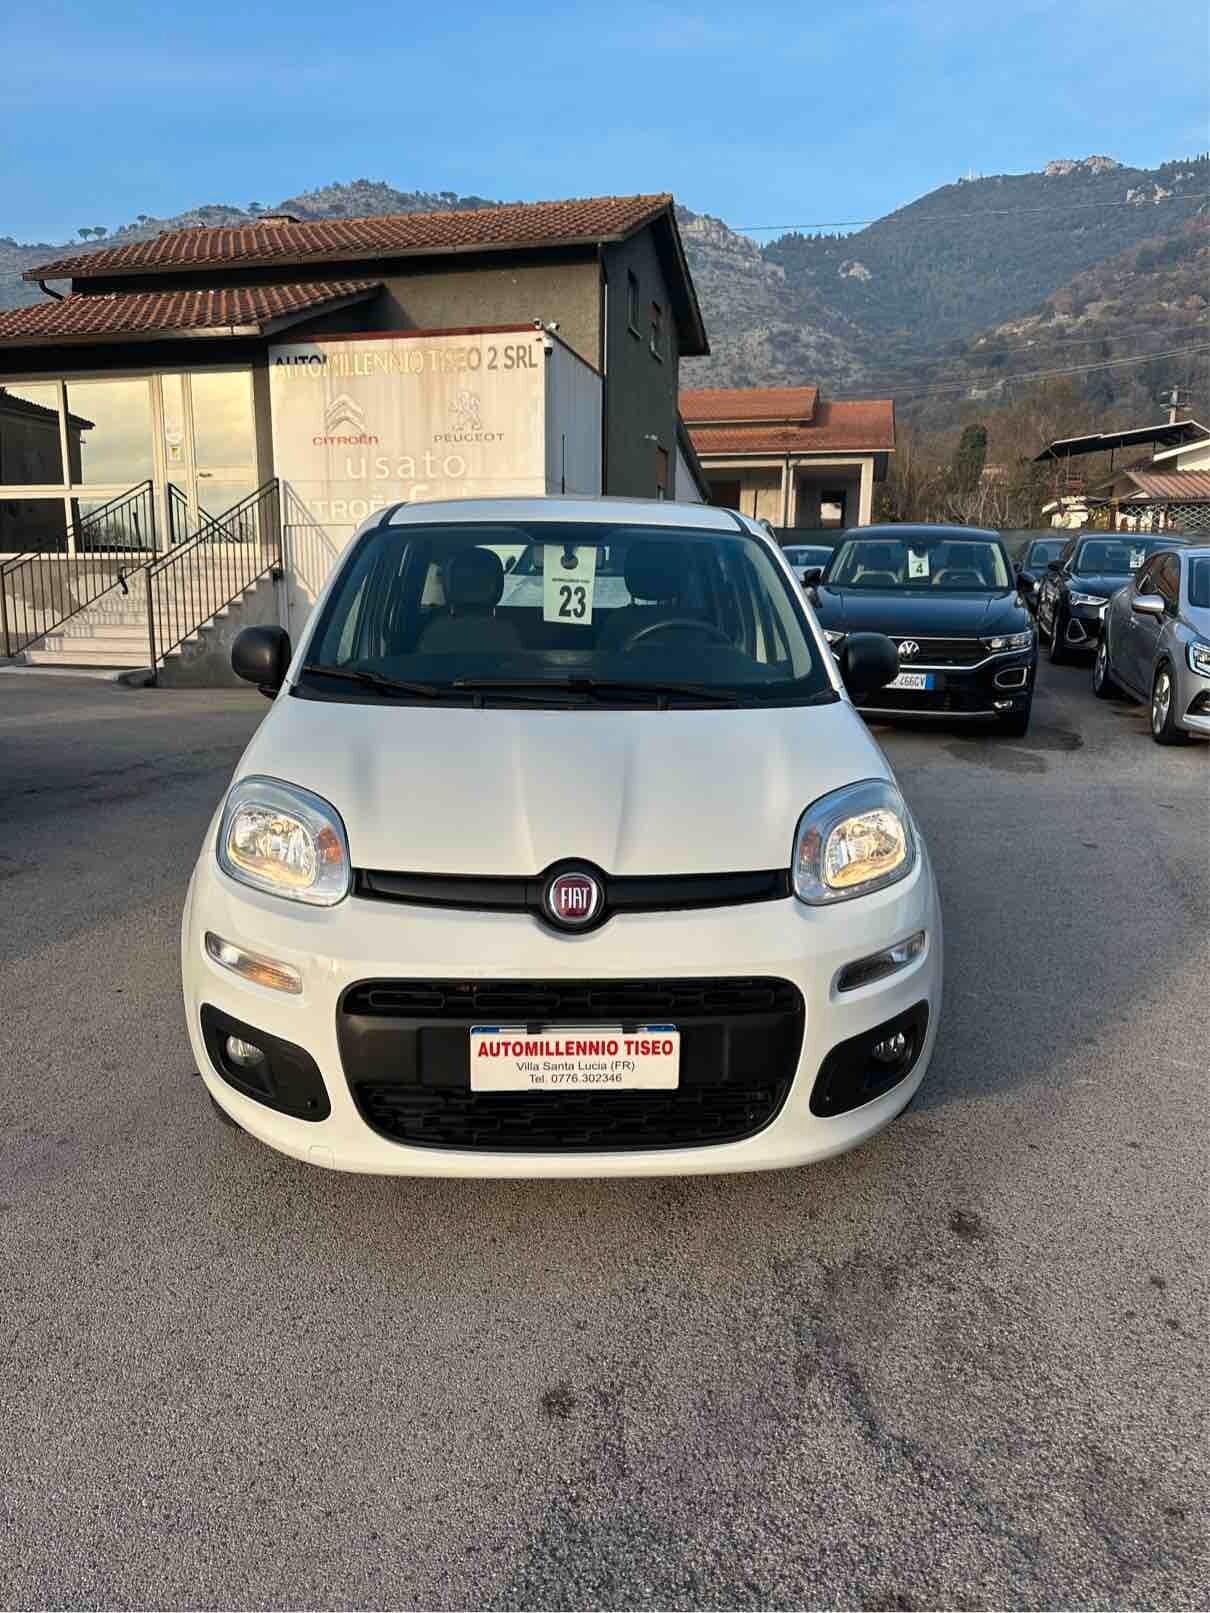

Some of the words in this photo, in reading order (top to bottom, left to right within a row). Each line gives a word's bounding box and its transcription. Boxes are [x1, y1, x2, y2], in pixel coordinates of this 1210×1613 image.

[275, 350, 424, 377] AUTOMILLENNIO
[425, 346, 481, 373] TISEO
[487, 345, 498, 370] 2
[503, 343, 539, 369] SRL
[433, 432, 505, 443] PEUGEOT
[346, 451, 466, 479] usato
[558, 585, 586, 618] 23
[561, 887, 590, 909] FIAT
[478, 1040, 619, 1057] AUTOMILLENNIO
[624, 1040, 673, 1056] TISEO
[515, 1061, 540, 1071] Villa
[543, 1061, 575, 1071] Santa
[578, 1060, 607, 1071] Lucia
[610, 1060, 635, 1073] (FR)
